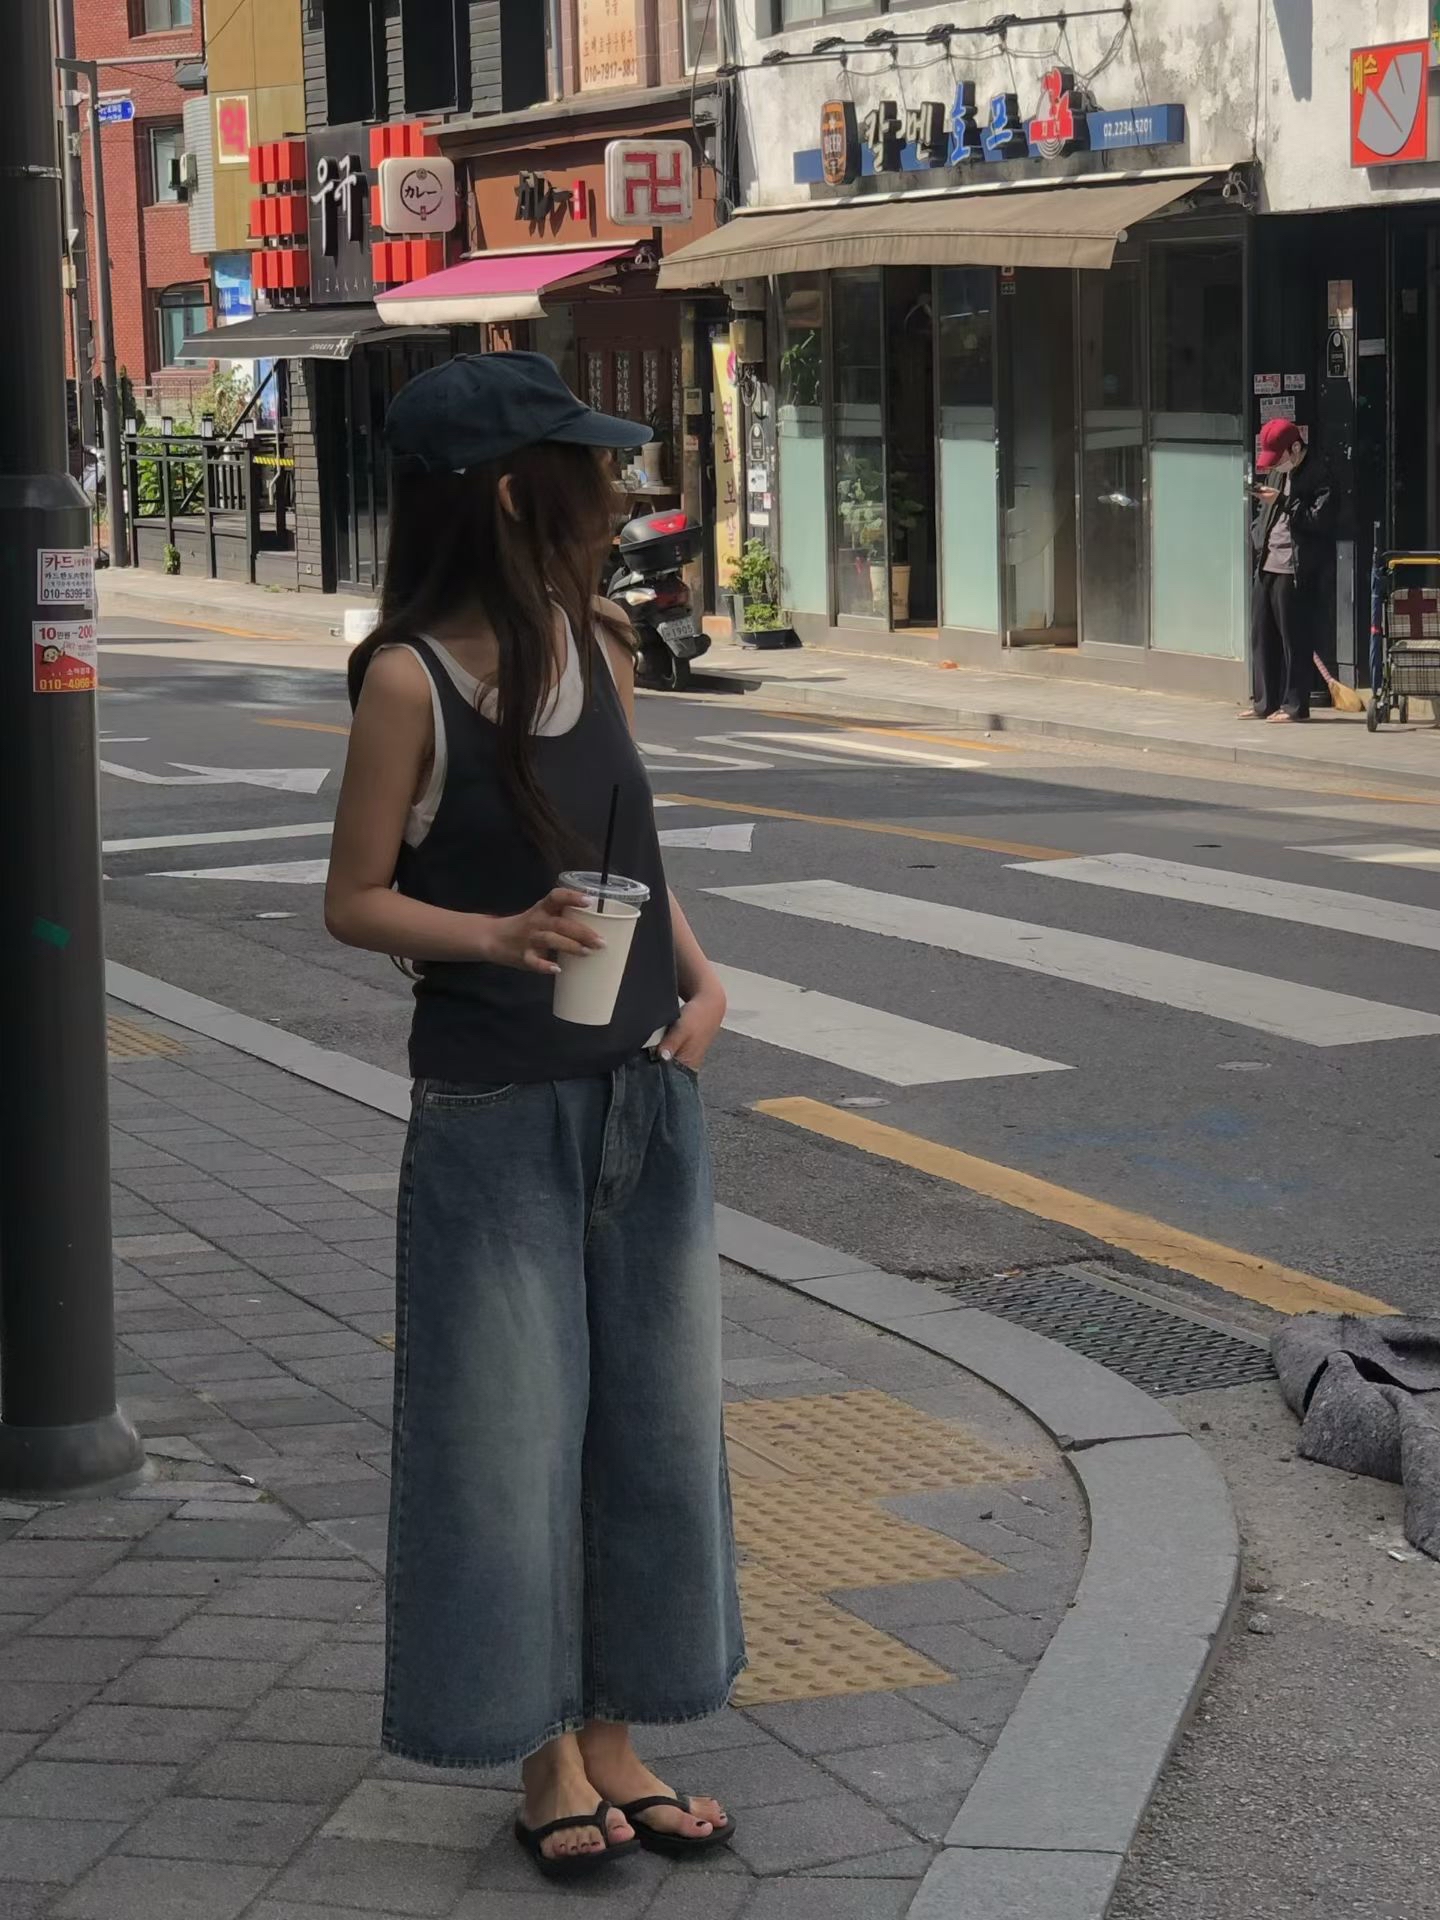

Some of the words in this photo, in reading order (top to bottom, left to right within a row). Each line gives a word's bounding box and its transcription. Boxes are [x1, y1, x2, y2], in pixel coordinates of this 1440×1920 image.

[404, 185, 437, 198] カレー
[44, 554, 75, 571] 카드
